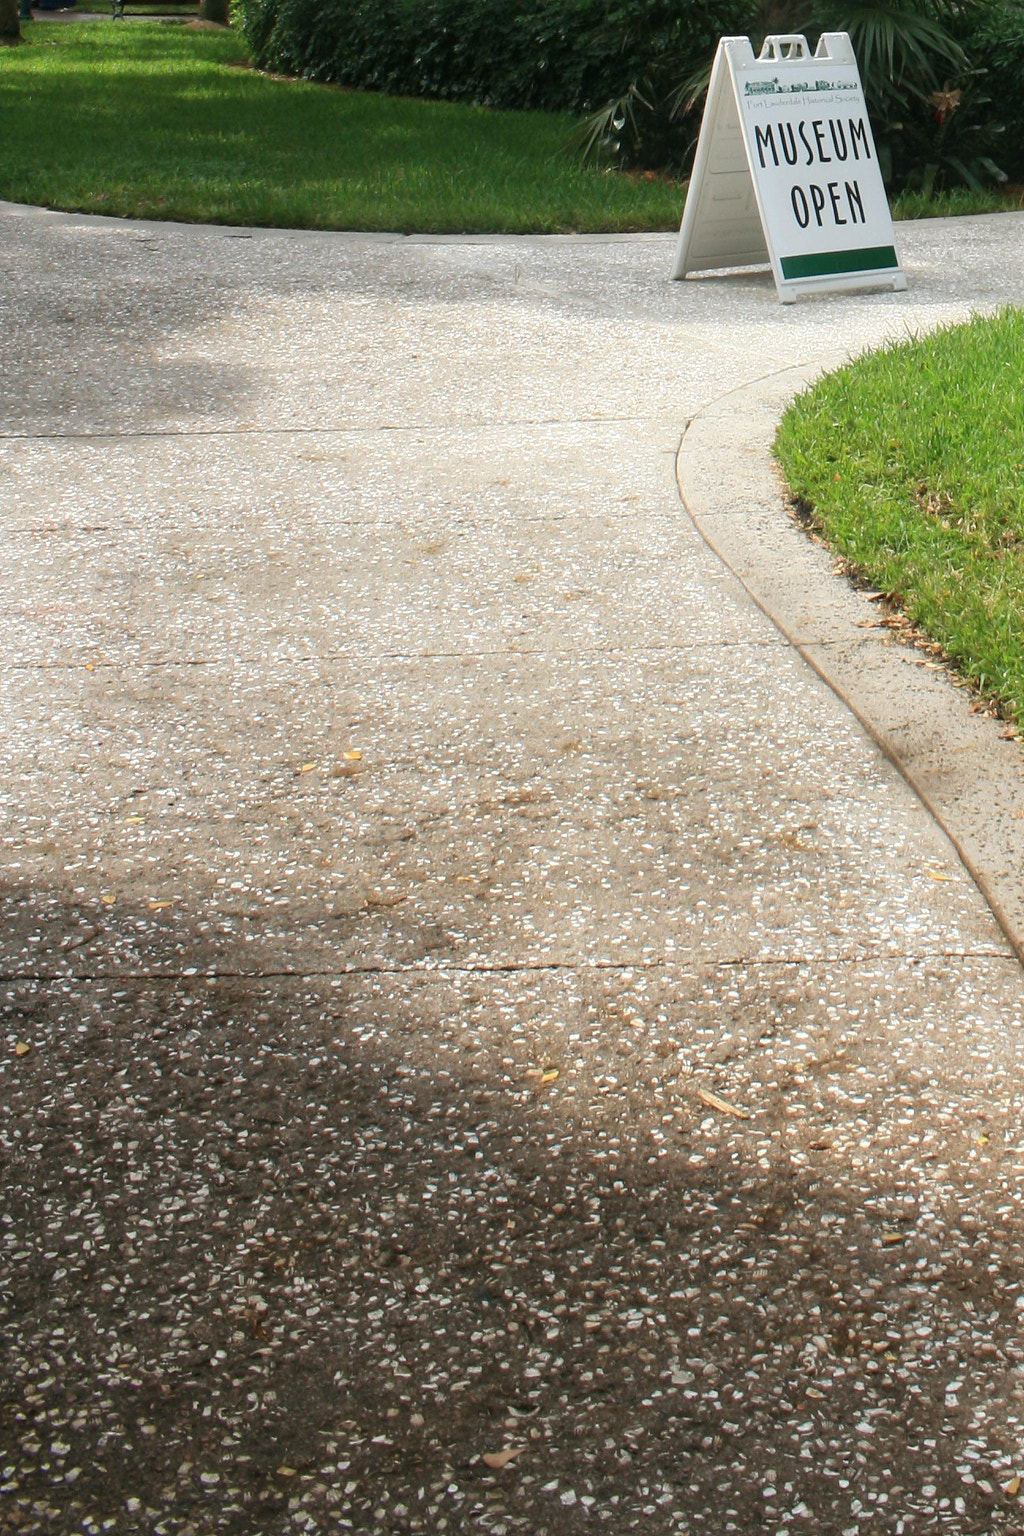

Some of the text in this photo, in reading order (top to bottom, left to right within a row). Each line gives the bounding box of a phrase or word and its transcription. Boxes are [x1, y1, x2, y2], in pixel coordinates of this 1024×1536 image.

[835, 94, 860, 105] Society
[755, 118, 871, 168] MUSEUM
[790, 180, 866, 229] OPEN
